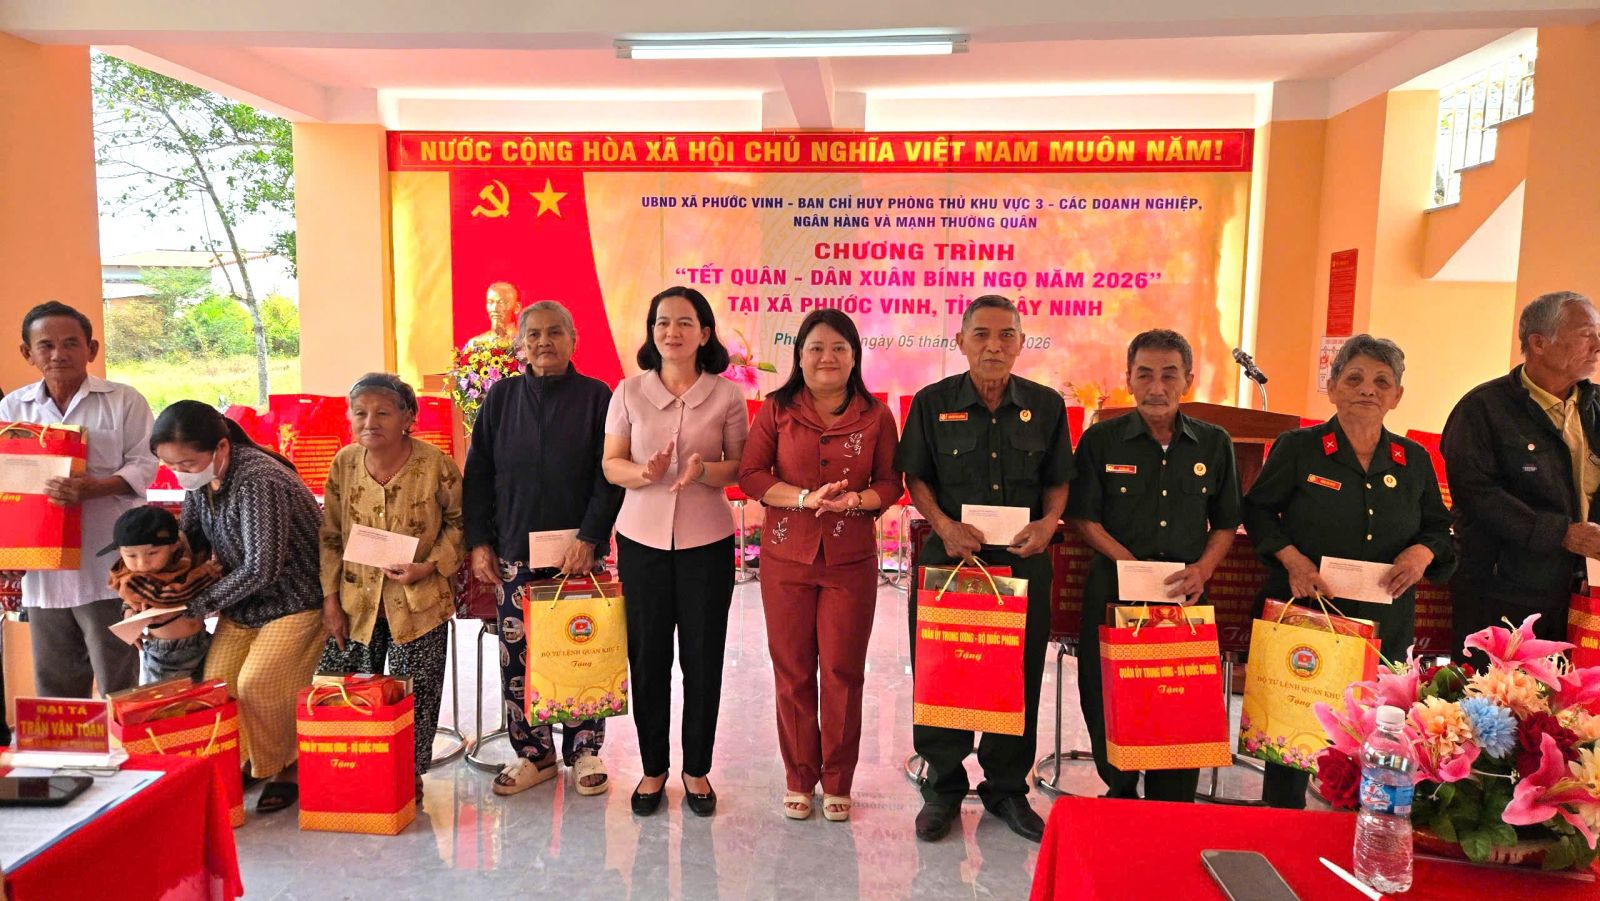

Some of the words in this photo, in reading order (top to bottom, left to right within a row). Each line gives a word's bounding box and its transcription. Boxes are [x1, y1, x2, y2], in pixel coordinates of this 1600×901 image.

[420, 136, 492, 162] NƯỚC
[501, 136, 573, 166] CỘNG
[582, 136, 637, 162] HÒA
[645, 136, 679, 162] XÃ
[688, 136, 734, 166] HỘI
[744, 136, 800, 162] CHỦ
[811, 136, 895, 162] NGHĨA
[904, 136, 965, 167] VIỆT
[975, 141, 1038, 162] NAM
[1049, 135, 1135, 162] MUÔN
[1146, 135, 1223, 161] NĂM!
[642, 196, 677, 208] UBND
[681, 195, 698, 208] XÃ
[702, 195, 747, 208] PHƯỚC
[752, 197, 783, 208] VINH
[798, 198, 824, 209] BAN
[828, 195, 852, 209] CHỈ
[857, 198, 884, 209] HUY
[888, 196, 934, 209] PHÒNG
[939, 195, 966, 209] THỦ
[970, 198, 997, 209] KHU
[1003, 198, 1030, 212] VỰC
[1035, 198, 1044, 210] 3
[1059, 196, 1087, 210] CÁC
[1092, 198, 1140, 210] DOANH
[1145, 196, 1203, 211] NGHIỆP,
[793, 214, 829, 227] NGÂN
[833, 214, 869, 228] HÀNG
[874, 214, 891, 228] VÀ
[896, 217, 936, 230] MẠNH
[940, 215, 995, 228] THƯỜNG
[1000, 215, 1037, 229] QUÂN
[814, 240, 924, 260] CHƯƠNG
[934, 240, 1015, 261] TRÌNH
[675, 263, 724, 285] “TẾT
[730, 265, 787, 286] QUÂN
[811, 266, 852, 286] DÂN
[859, 267, 915, 287] XUÂN
[923, 267, 975, 287] BÍNH
[983, 271, 1027, 291] NGỌ
[1035, 269, 1084, 288] NĂM
[1092, 272, 1162, 289] 2026”
[728, 296, 759, 315] TẠI
[766, 294, 793, 313] XÃ
[800, 294, 872, 314] PHƯỚC
[880, 298, 937, 317] VINH,
[1010, 296, 1042, 316] ÂY
[1050, 300, 1103, 316] NINH
[860, 334, 893, 350] ngày
[898, 335, 914, 348] 05
[918, 335, 957, 351] tháng
[1021, 336, 1051, 349] 026
